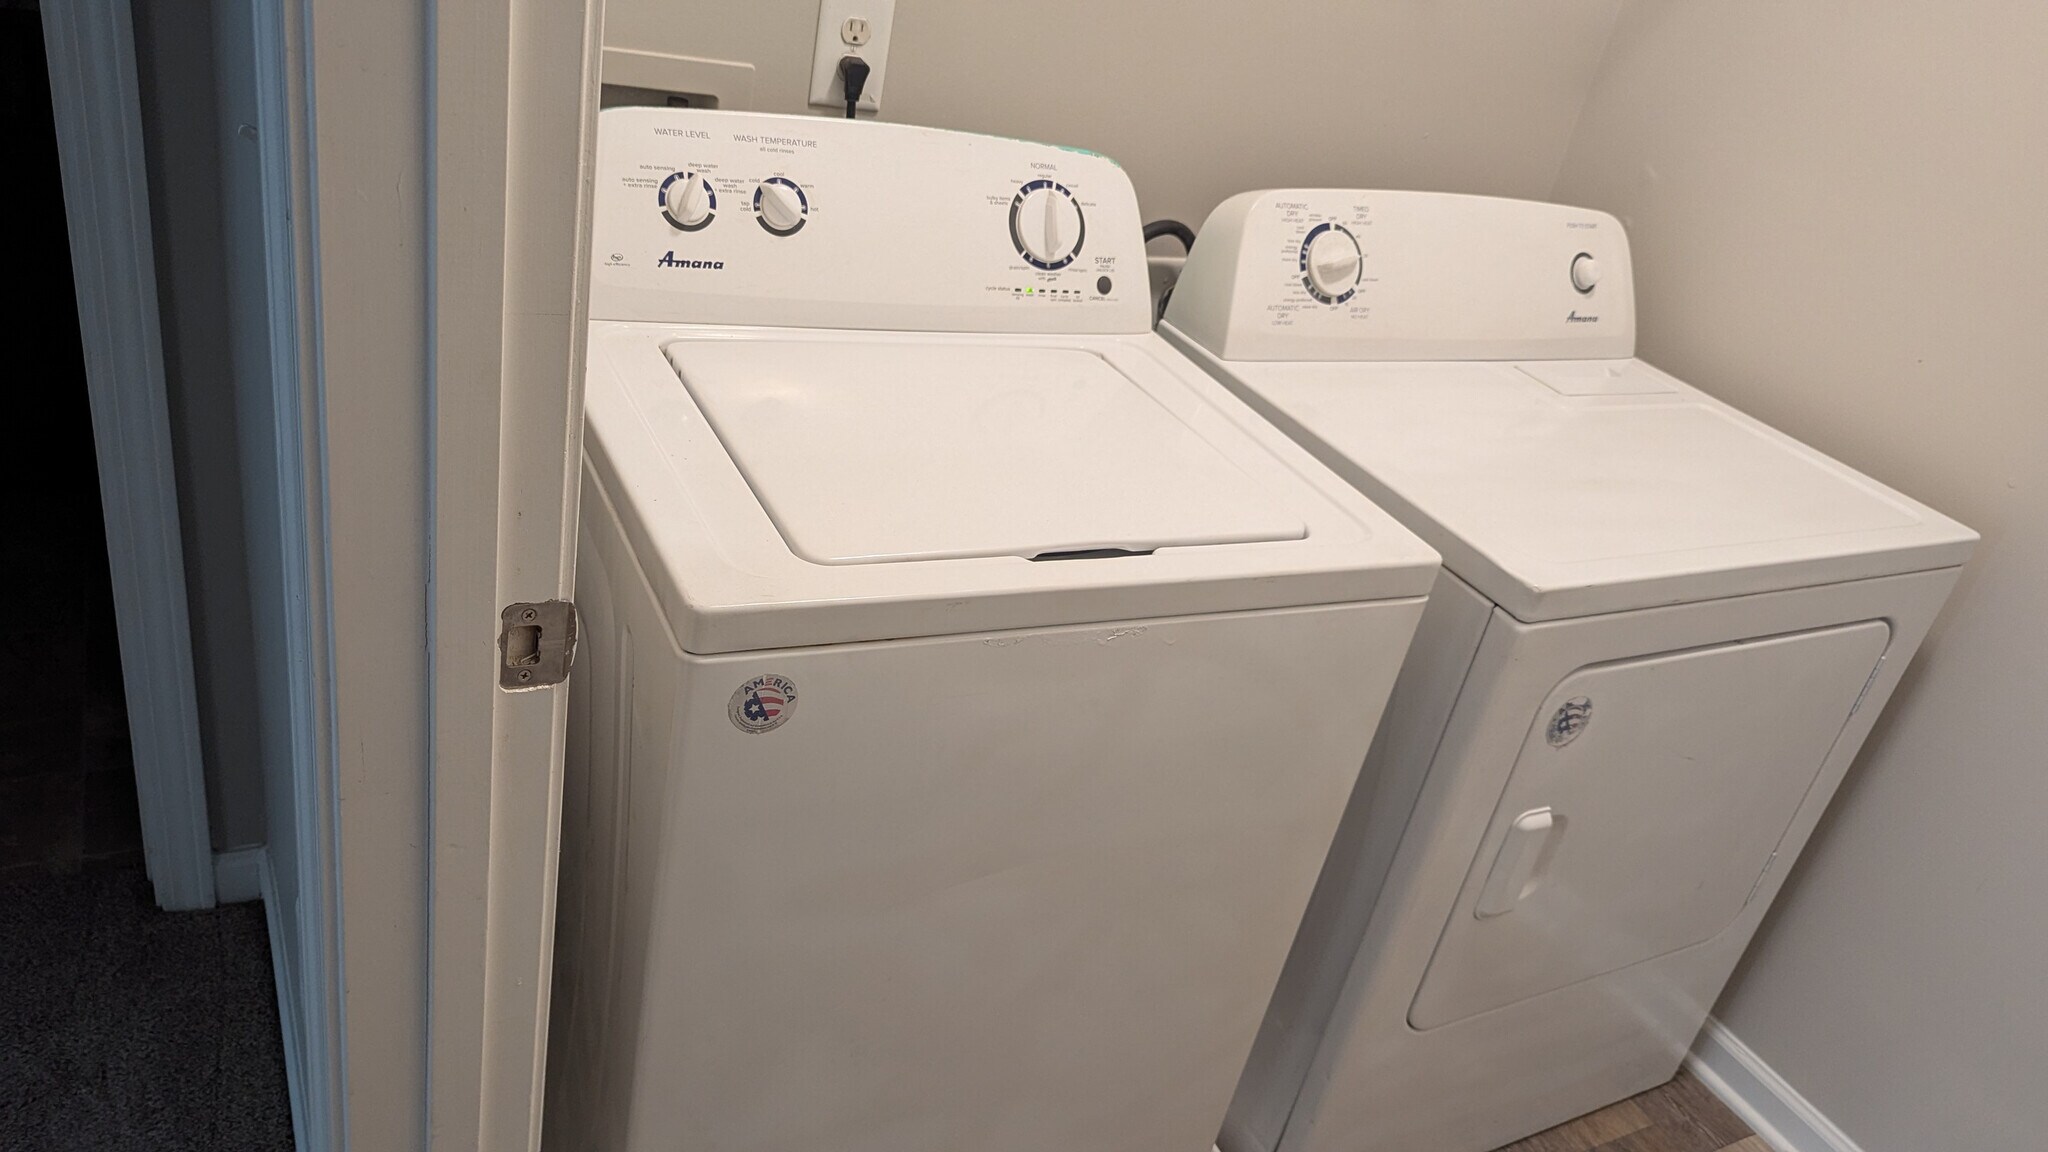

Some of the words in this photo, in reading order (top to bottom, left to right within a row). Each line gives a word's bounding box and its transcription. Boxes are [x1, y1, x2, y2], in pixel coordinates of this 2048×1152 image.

[653, 127, 684, 137] WATER
[685, 130, 711, 140] LEVEL
[733, 134, 758, 143] WASH
[760, 136, 817, 149] TEMPERATURE
[653, 165, 676, 173] sensing
[1030, 162, 1058, 172] NORMAL
[1275, 202, 1309, 211] AUTOMATIC
[658, 251, 724, 270] Amana
[1094, 257, 1116, 265] START
[1266, 304, 1300, 312] AUTOMATIC
[1565, 310, 1599, 323] Amana
[743, 677, 796, 704] AMERICA
